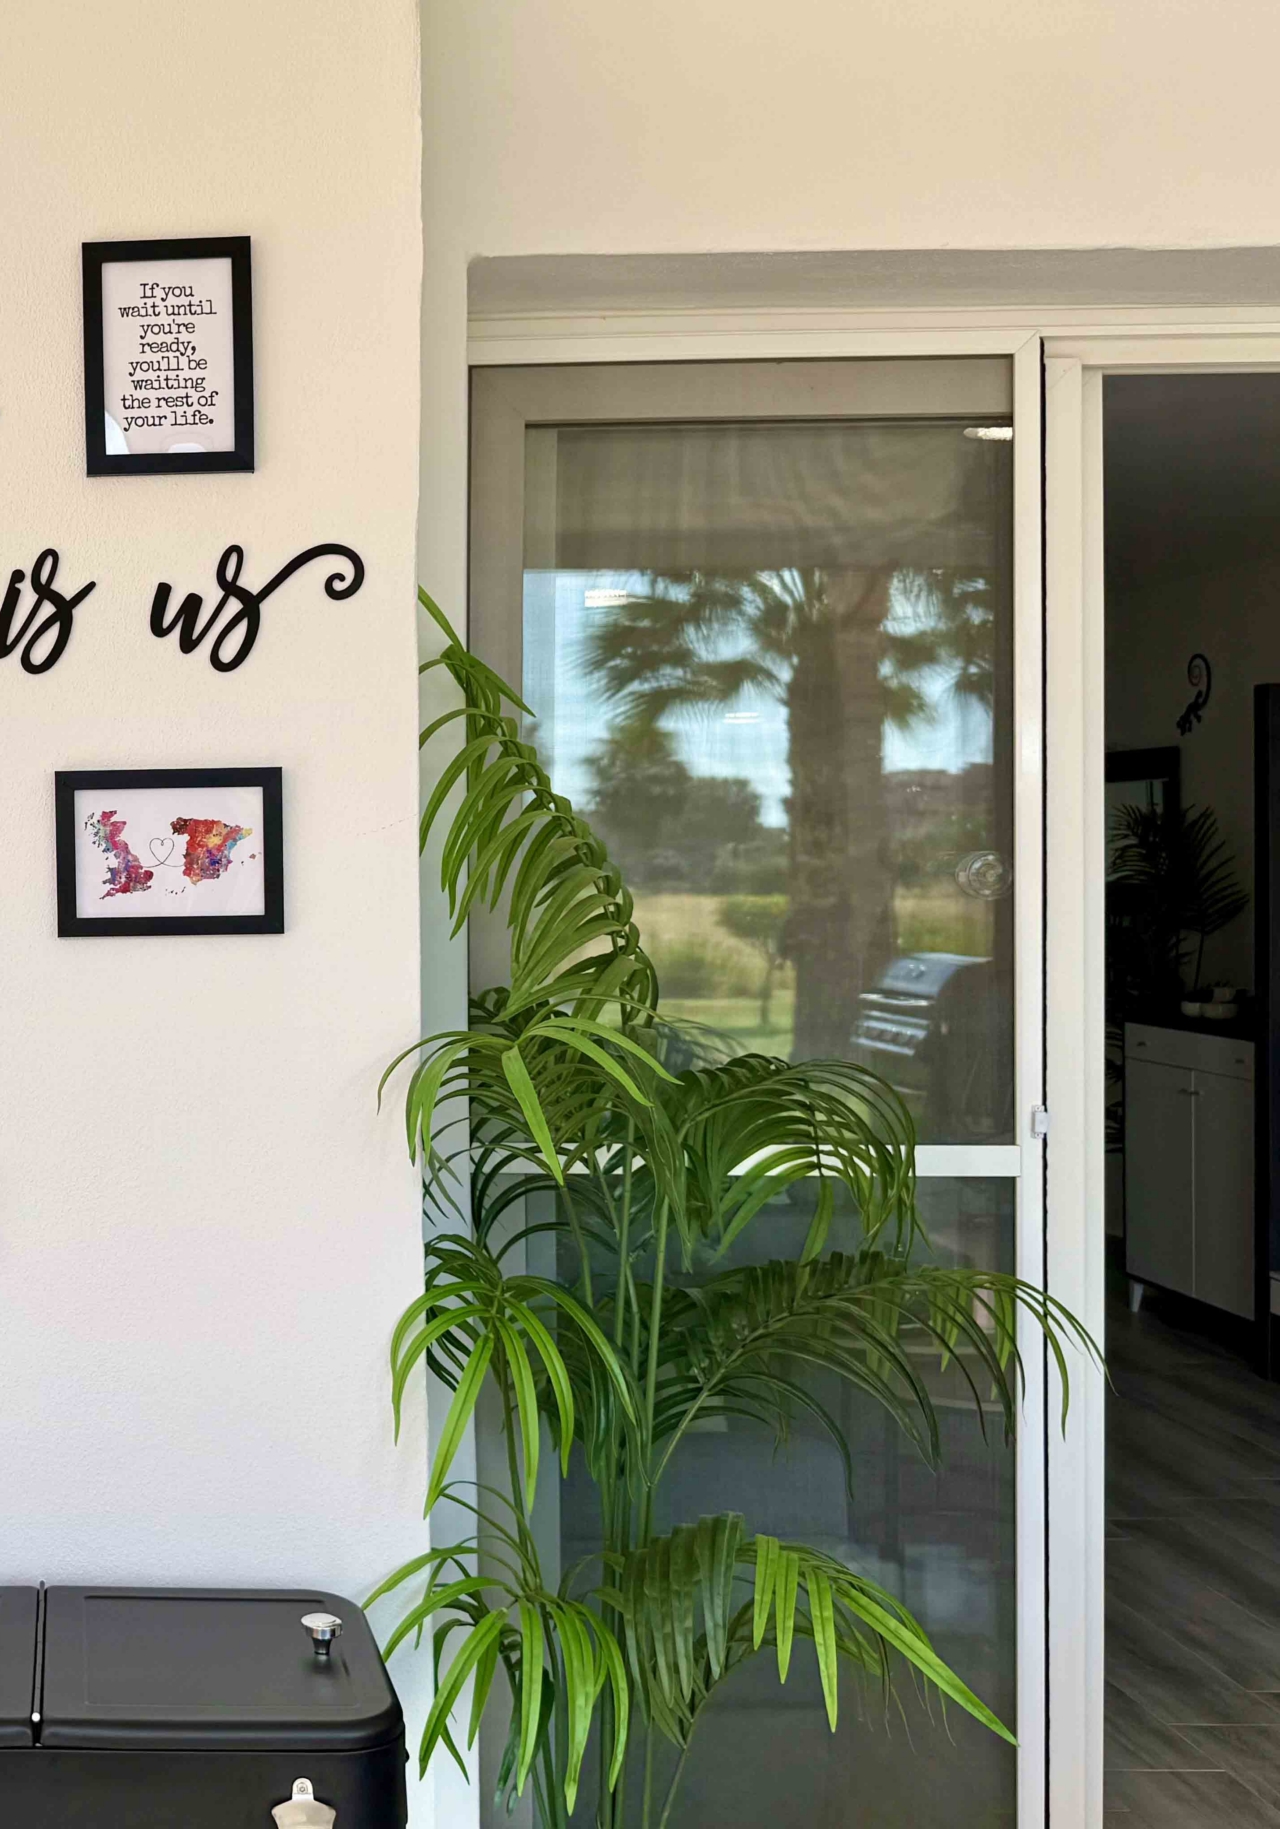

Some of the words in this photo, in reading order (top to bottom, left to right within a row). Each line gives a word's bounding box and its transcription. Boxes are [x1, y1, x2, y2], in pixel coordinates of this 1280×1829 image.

[139, 282, 159, 299] If
[160, 285, 195, 302] you
[118, 302, 161, 318] wait
[163, 300, 217, 317] until
[139, 319, 196, 340] you're
[139, 338, 197, 357] ready,
[128, 356, 184, 377] you'll
[187, 355, 208, 371] be
[131, 374, 206, 392] waiting
[121, 394, 151, 410] the
[155, 392, 194, 409] rest
[197, 391, 219, 407] of
[123, 414, 167, 432] your
[170, 411, 214, 427] life.
[150, 543, 365, 673] us
